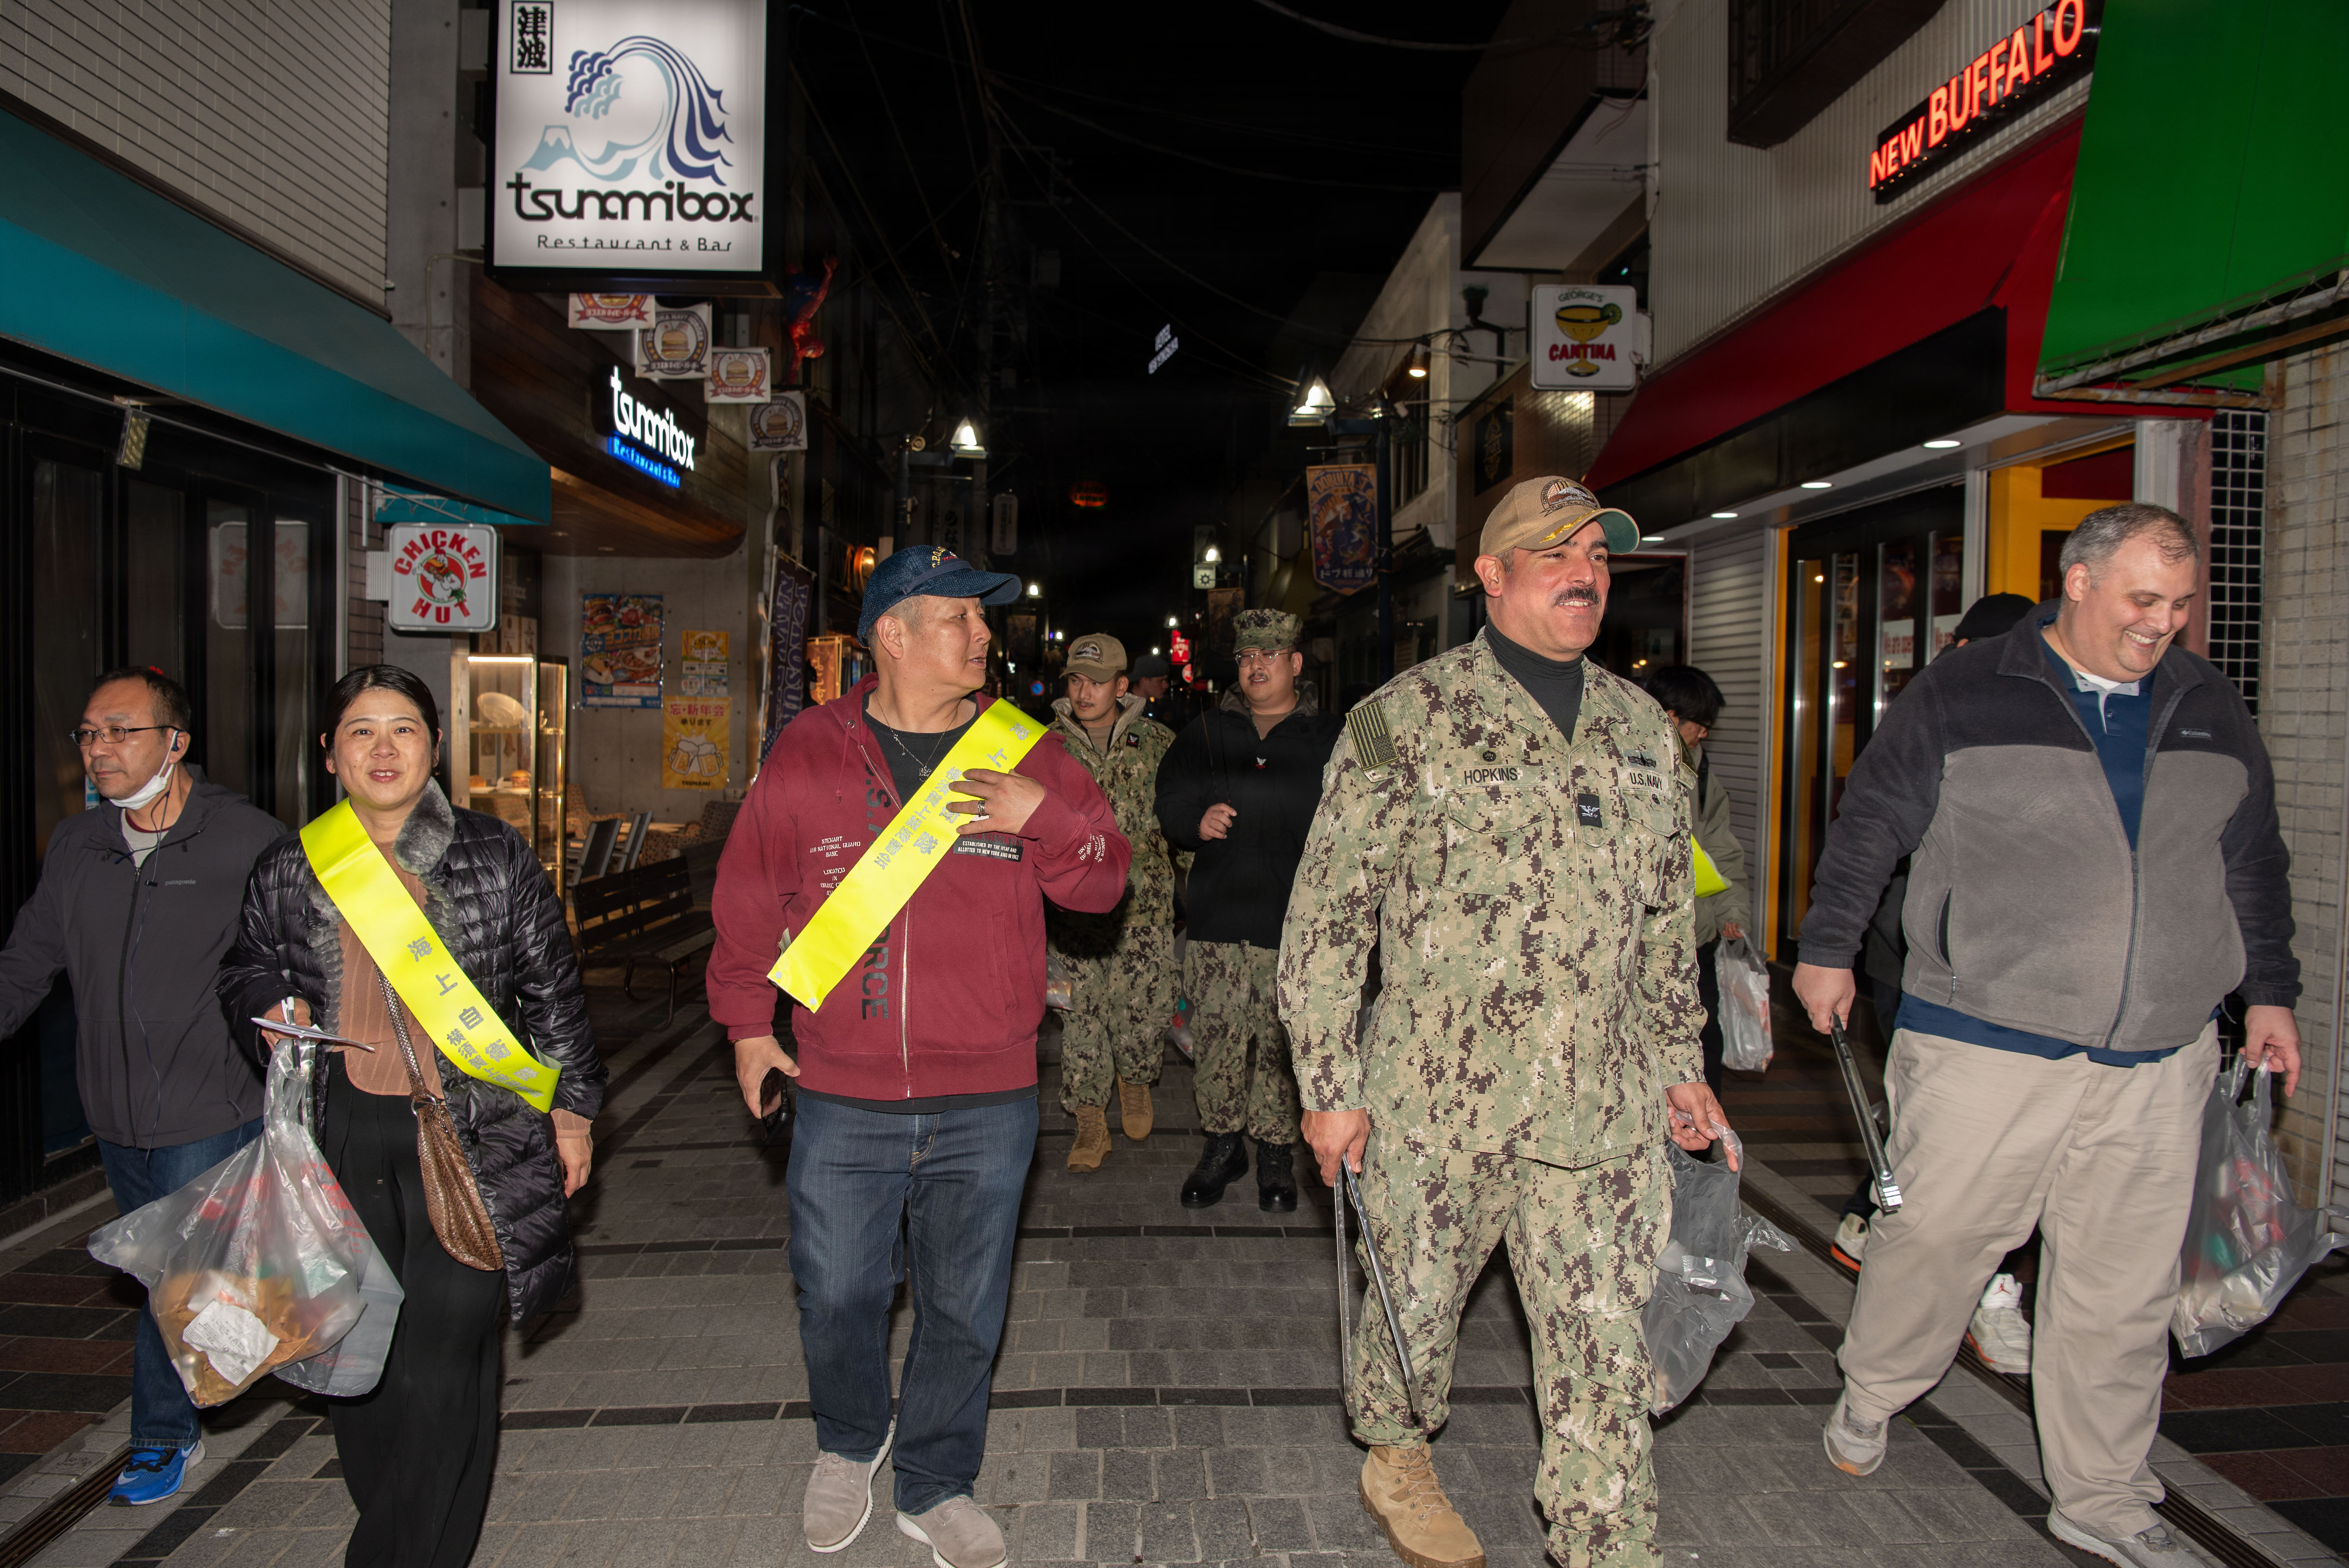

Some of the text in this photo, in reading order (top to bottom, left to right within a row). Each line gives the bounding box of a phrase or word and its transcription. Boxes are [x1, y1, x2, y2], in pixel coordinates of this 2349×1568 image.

[518, 6, 547, 68] 津波
[1870, 0, 2084, 188] NEW BUFFALO
[506, 171, 754, 223] tsunamibox
[537, 235, 732, 251] Restaurant & Bar
[1558, 290, 1604, 302] GEORGE'S
[1549, 344, 1616, 361] CANTINA
[610, 365, 695, 470] tsunamibox
[614, 436, 662, 479] Restaurant
[667, 467, 680, 488] Bar
[1314, 472, 1369, 492] DOBUITA ST
[394, 530, 487, 579] CHICKEN
[411, 597, 471, 624] HUT
[782, 583, 809, 727] YOKOSUK
[670, 704, 725, 717] 忘・新年会
[680, 718, 713, 727] 承ります
[913, 722, 1030, 855] 海上衛隊
[1463, 768, 1518, 786] HOPKINS
[1629, 772, 1663, 790] U.S. NAVY
[817, 843, 841, 852] NATIONAL
[408, 936, 539, 1082] 海上自衛隊
